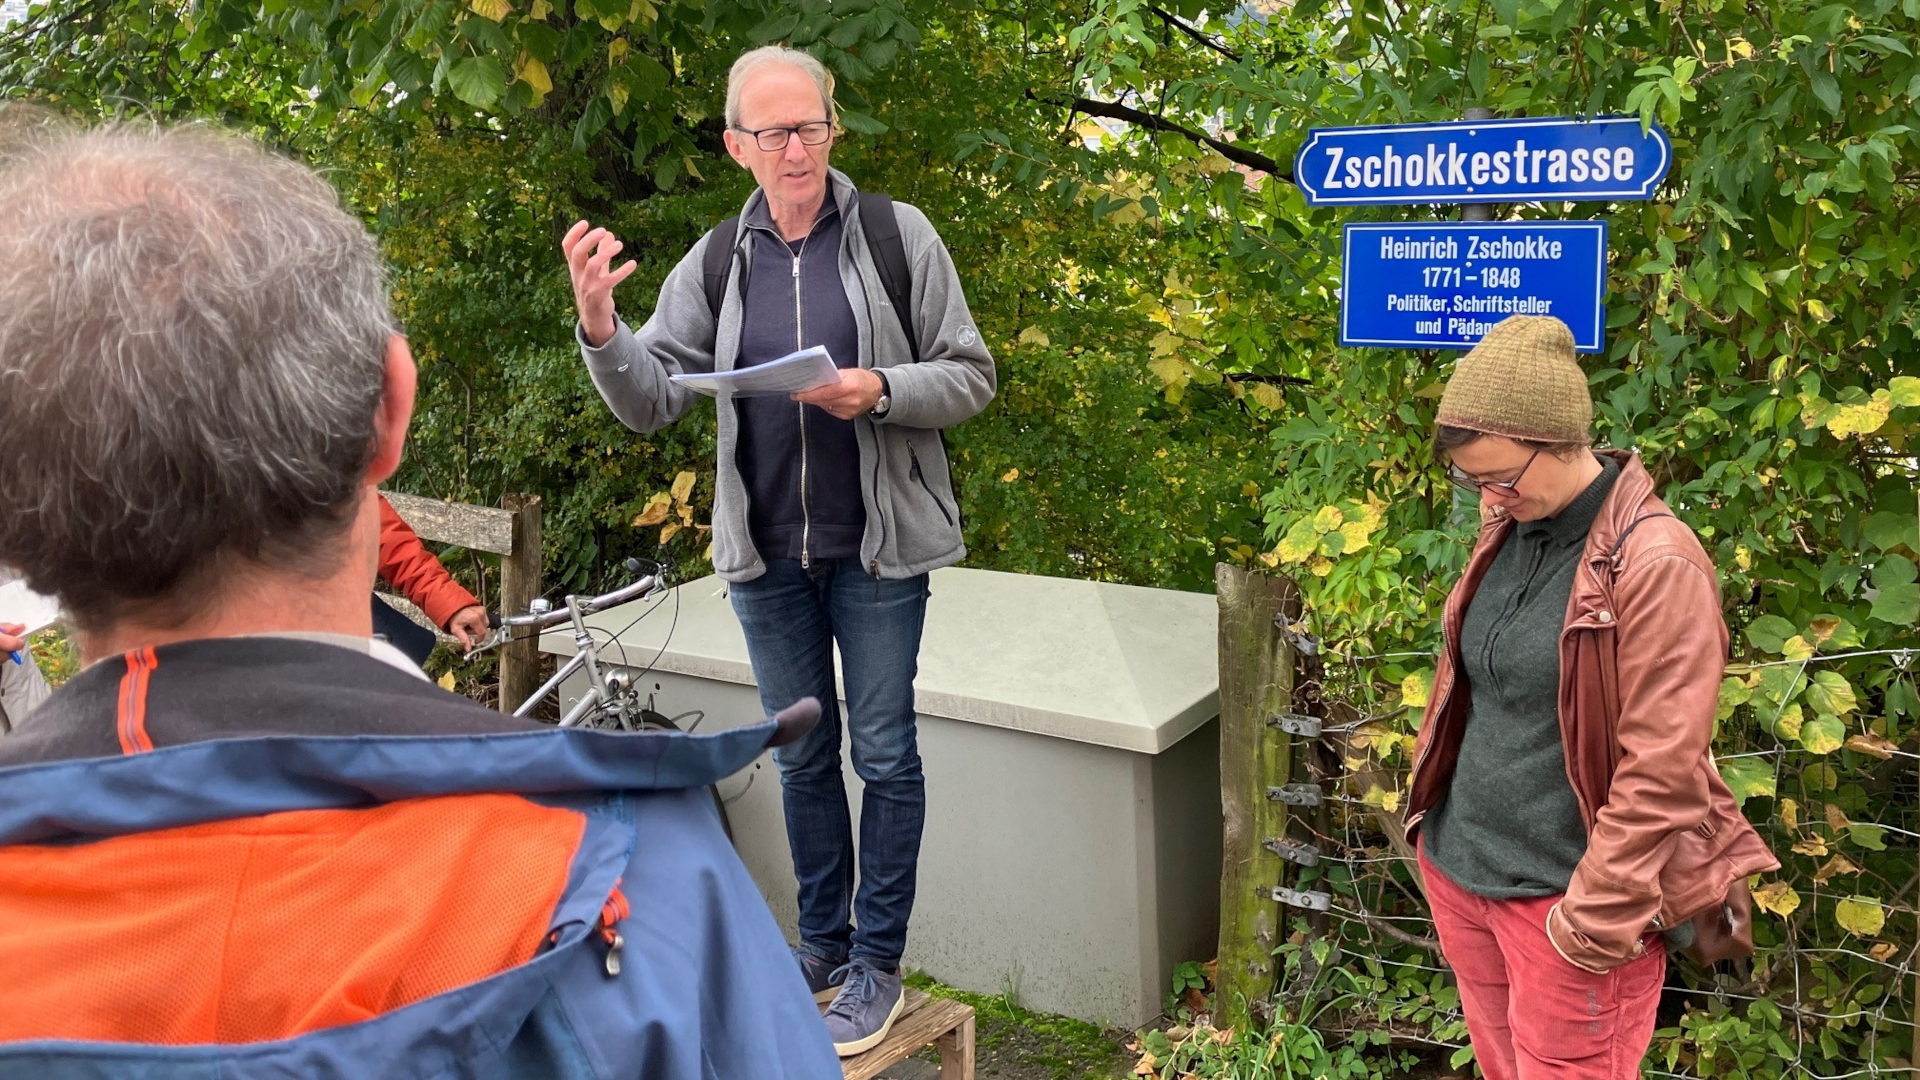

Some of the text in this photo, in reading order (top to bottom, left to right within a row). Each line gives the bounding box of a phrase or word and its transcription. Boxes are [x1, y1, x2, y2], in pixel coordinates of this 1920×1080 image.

[1323, 139, 1635, 189] Zschokkestrasse
[1380, 235, 1562, 260] Heinrich Zschokke
[1415, 317, 1442, 335] und
